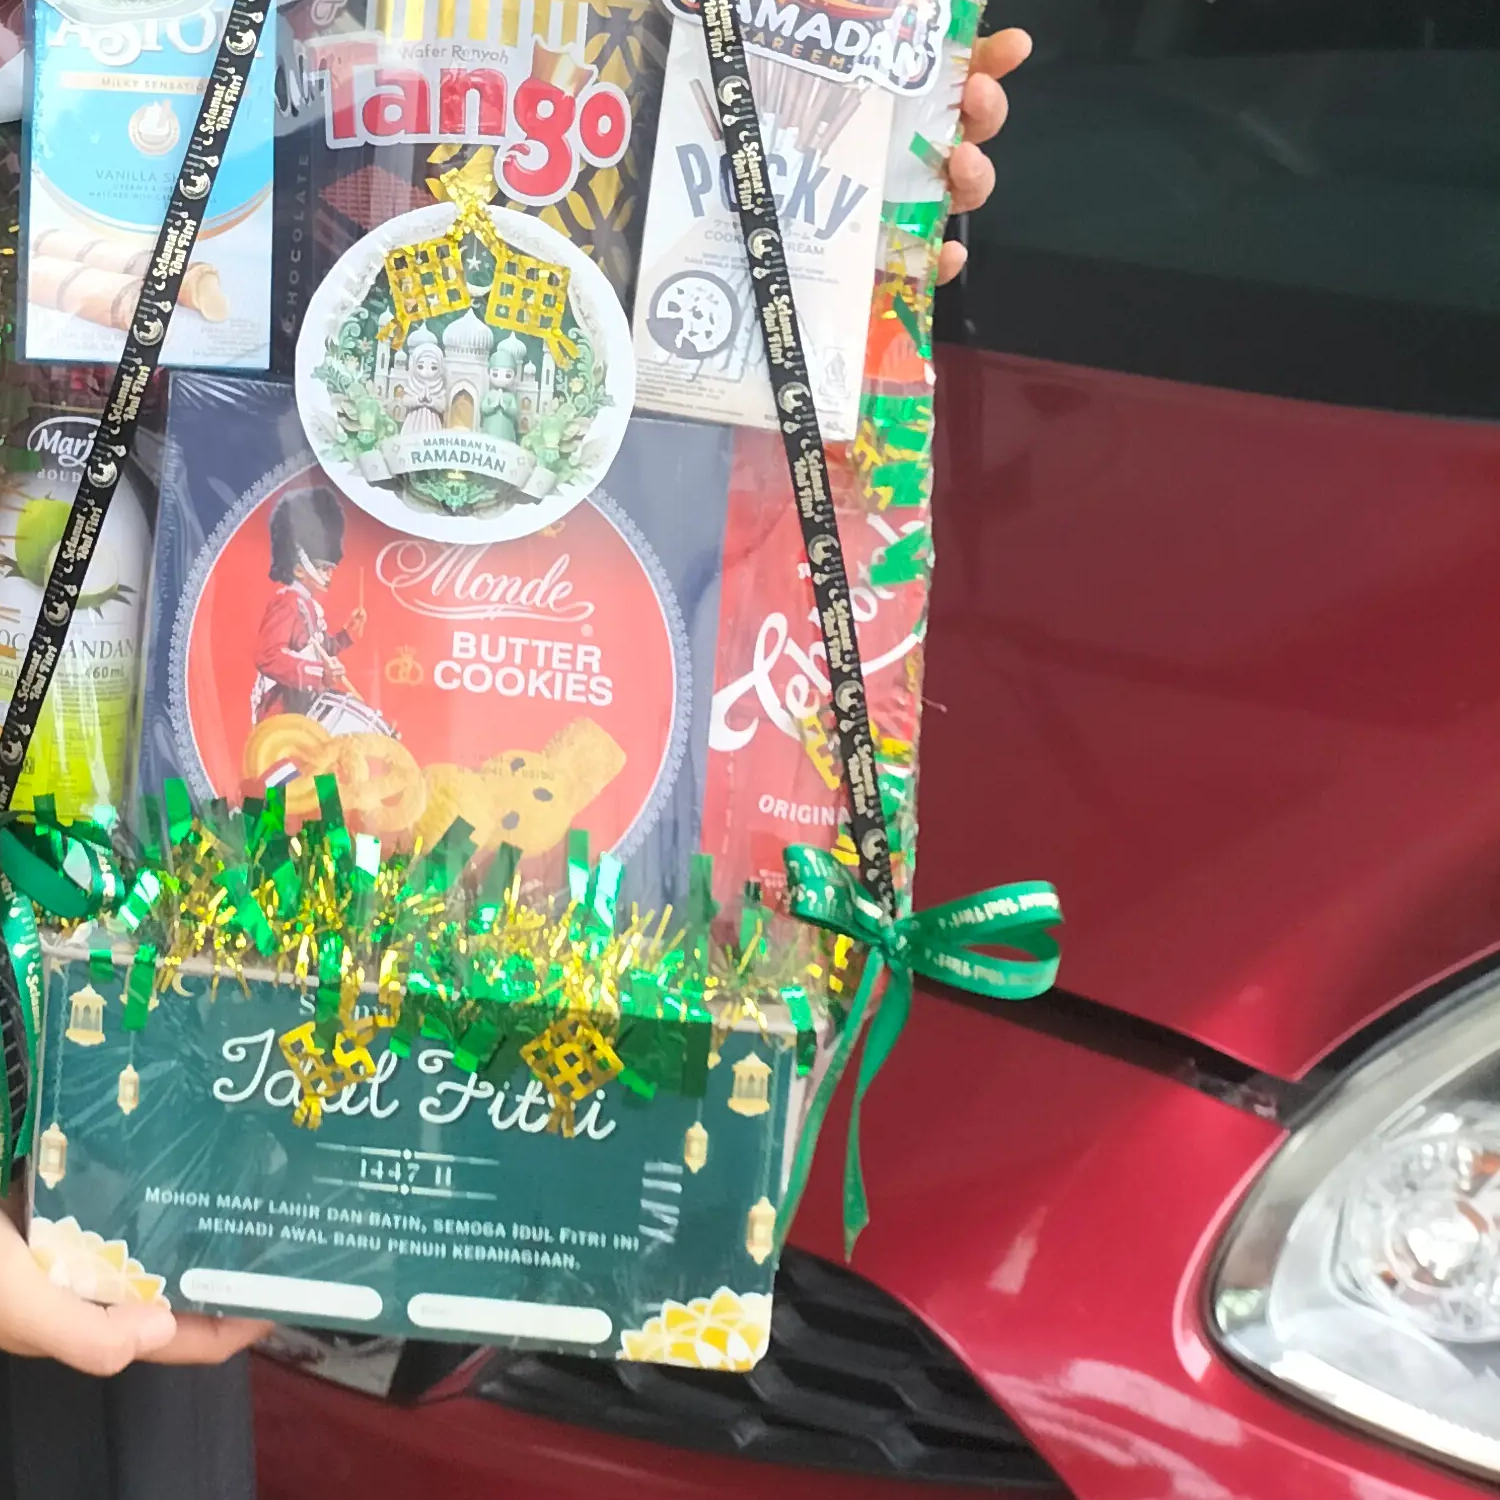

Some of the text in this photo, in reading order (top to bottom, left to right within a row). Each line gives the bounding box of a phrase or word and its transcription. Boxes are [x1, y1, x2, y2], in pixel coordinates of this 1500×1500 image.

[399, 44, 447, 61] Wafer
[101, 77, 206, 92] MILKY SENSATIO
[312, 36, 629, 202] Tango
[35, 428, 98, 469] Marj
[410, 449, 506, 473] RAMADHAN
[422, 438, 497, 454] MARHABAN YA
[376, 541, 594, 617] Monde
[452, 630, 602, 674] BUTTER
[433, 659, 613, 707] COOKIES
[758, 793, 853, 826] ORIGINA
[359, 1157, 421, 1184] 1447
[145, 1187, 211, 1208] MOHON
[216, 1194, 264, 1212] MAAF
[268, 1199, 320, 1220] LAHIR
[327, 1206, 363, 1225] DAN
[433, 1218, 507, 1239] SEMOGA
[512, 1222, 554, 1244] IDUL
[559, 1227, 607, 1248] FITRI
[612, 1233, 640, 1252] INI
[198, 1217, 274, 1238] MENJADI
[279, 1225, 328, 1245] AWAL
[333, 1231, 381, 1252] BARU
[387, 1237, 447, 1259] PENUH
